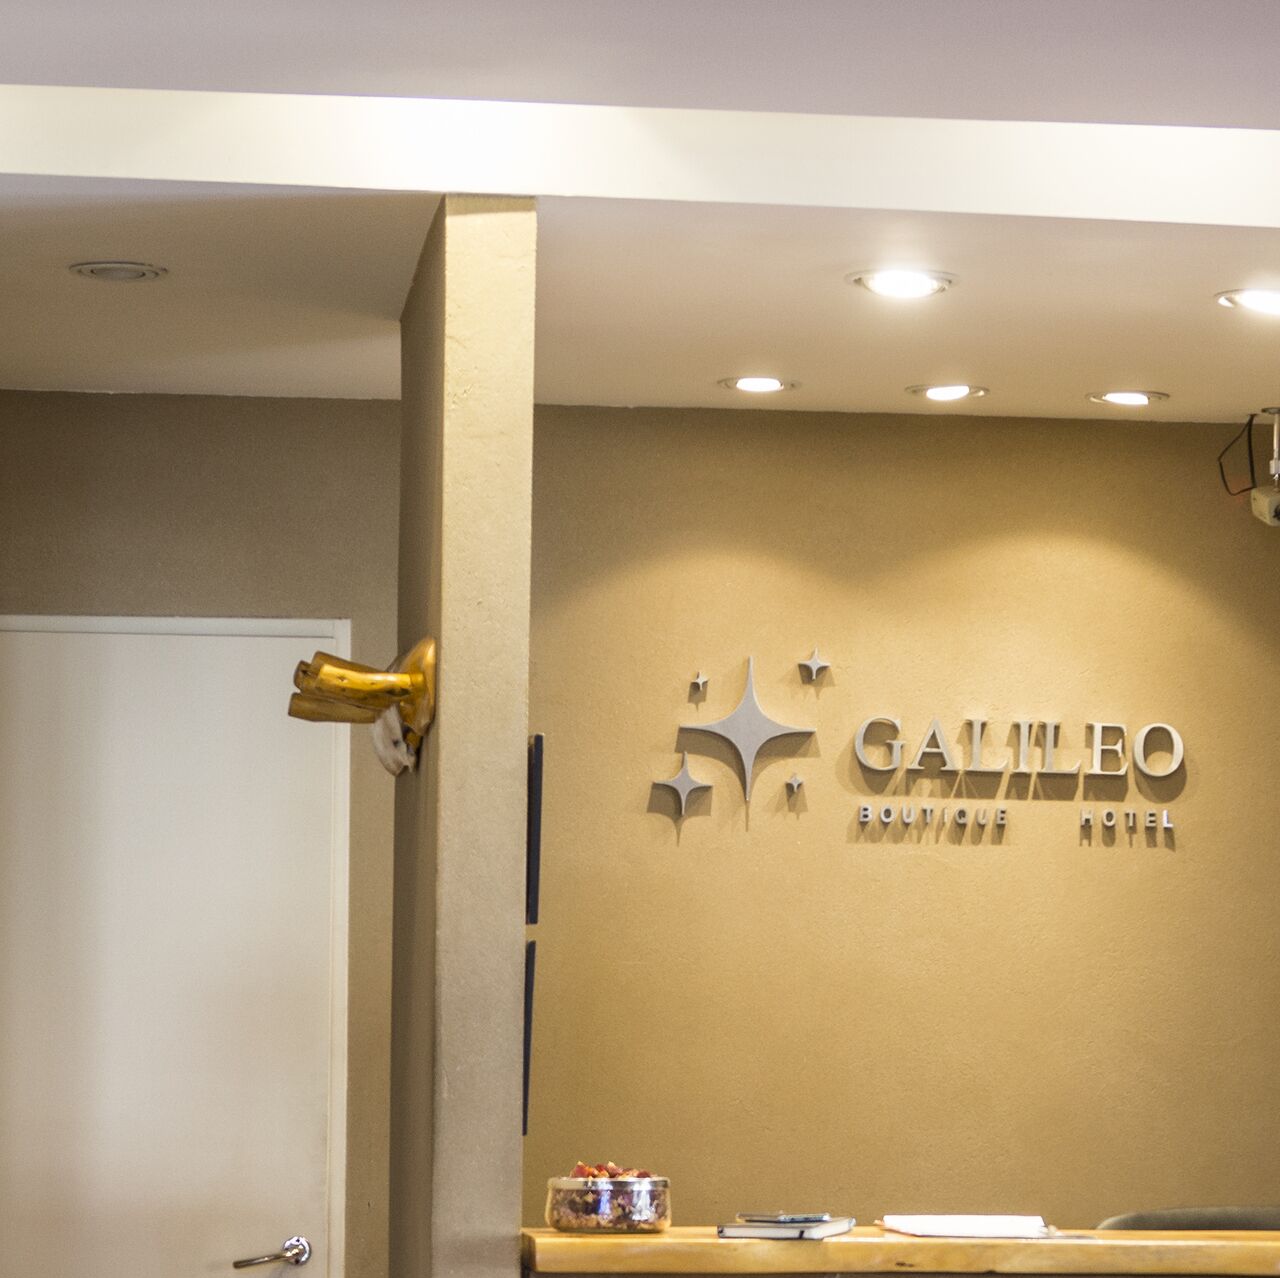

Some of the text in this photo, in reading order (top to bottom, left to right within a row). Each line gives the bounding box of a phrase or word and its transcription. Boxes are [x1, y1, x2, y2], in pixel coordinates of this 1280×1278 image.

[854, 717, 1184, 778] GALILEO
[858, 805, 1174, 828] BOUTIQUE HOTEL
